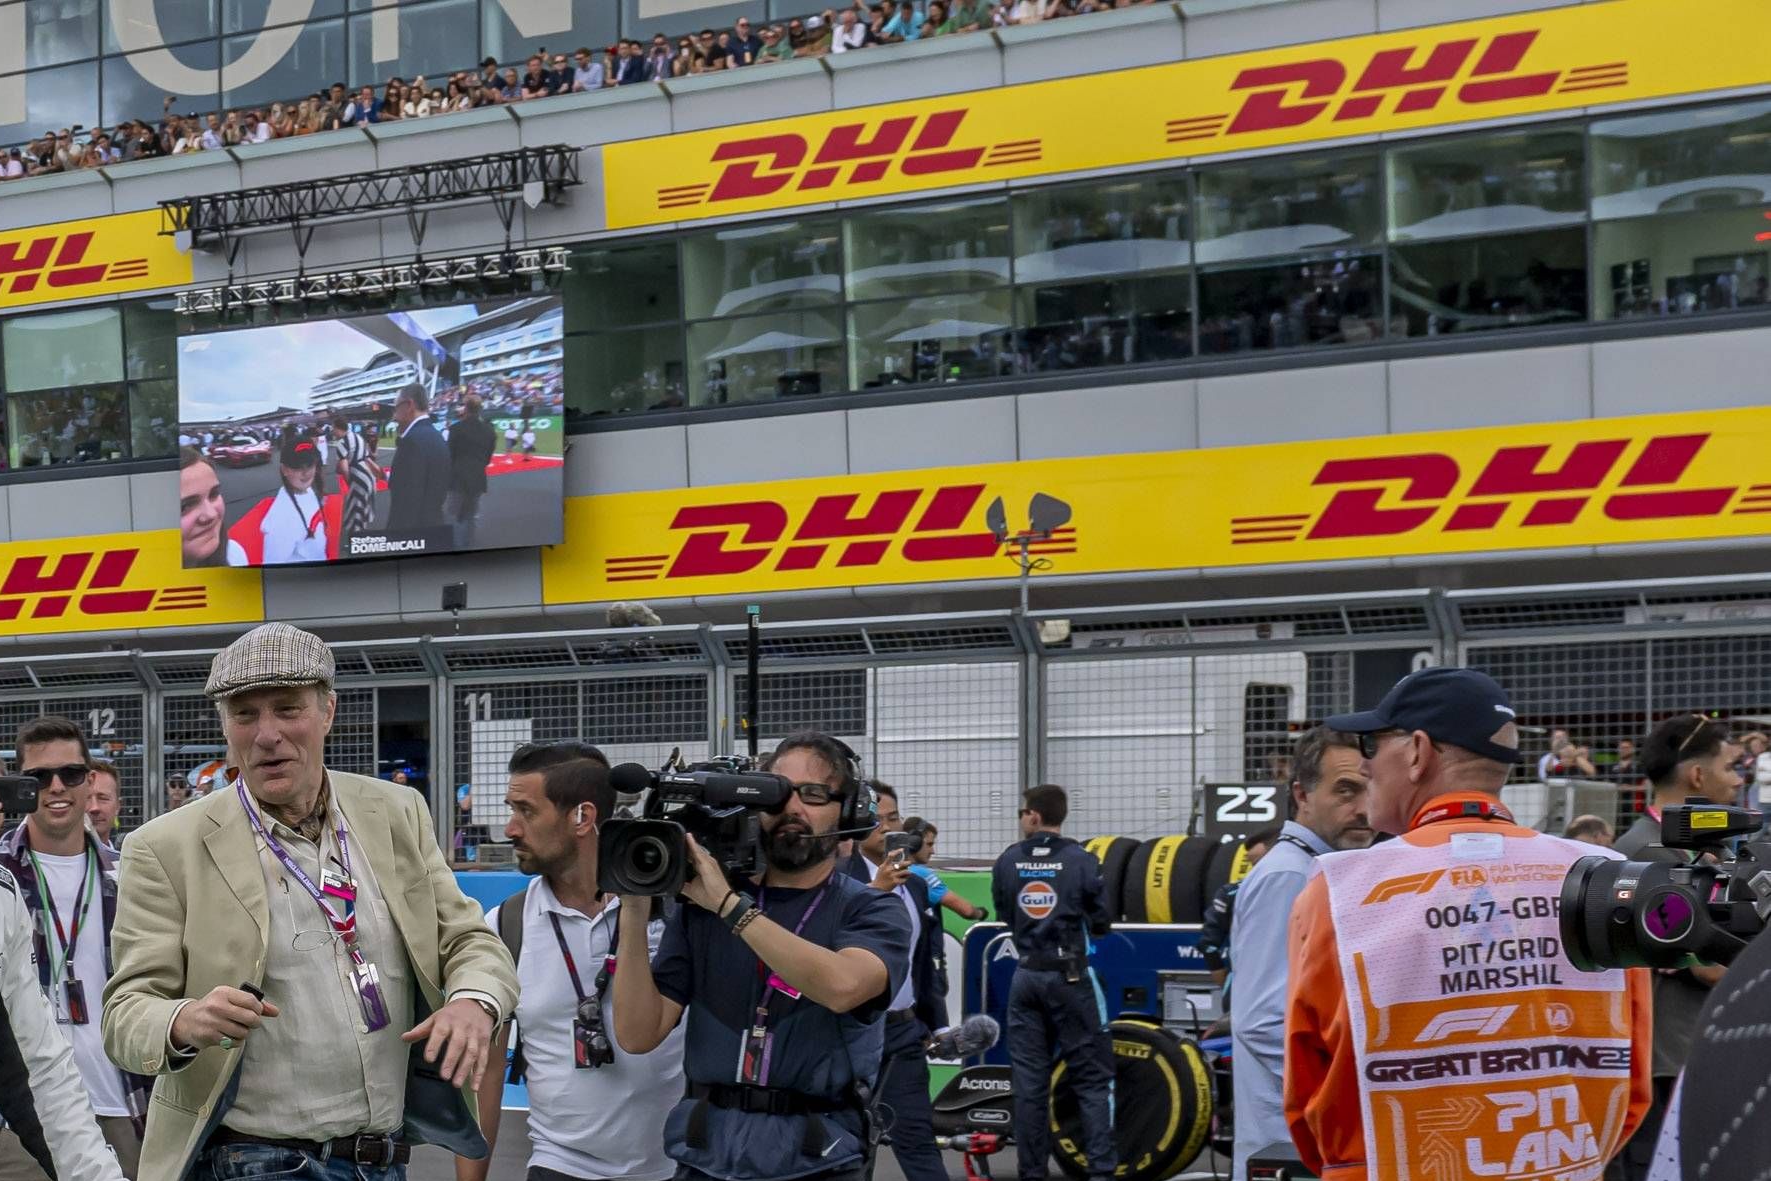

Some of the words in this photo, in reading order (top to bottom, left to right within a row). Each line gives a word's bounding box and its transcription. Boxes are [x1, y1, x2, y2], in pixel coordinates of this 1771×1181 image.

[1224, 30, 1560, 136] DHL
[708, 108, 986, 202] DHL
[1307, 432, 1737, 541] DHL
[666, 483, 1007, 579] DHL
[350, 540, 426, 555] DOMENICALI
[464, 692, 492, 721] 11
[89, 707, 116, 737] 12
[1216, 786, 1277, 822] 23
[1015, 862, 1063, 870] WILLIAMS
[1021, 894, 1054, 905] Gulf
[1442, 937, 1559, 968] PIT/GRID
[1366, 1053, 1477, 1082] GREAT
[959, 1077, 1011, 1090] Acronis
